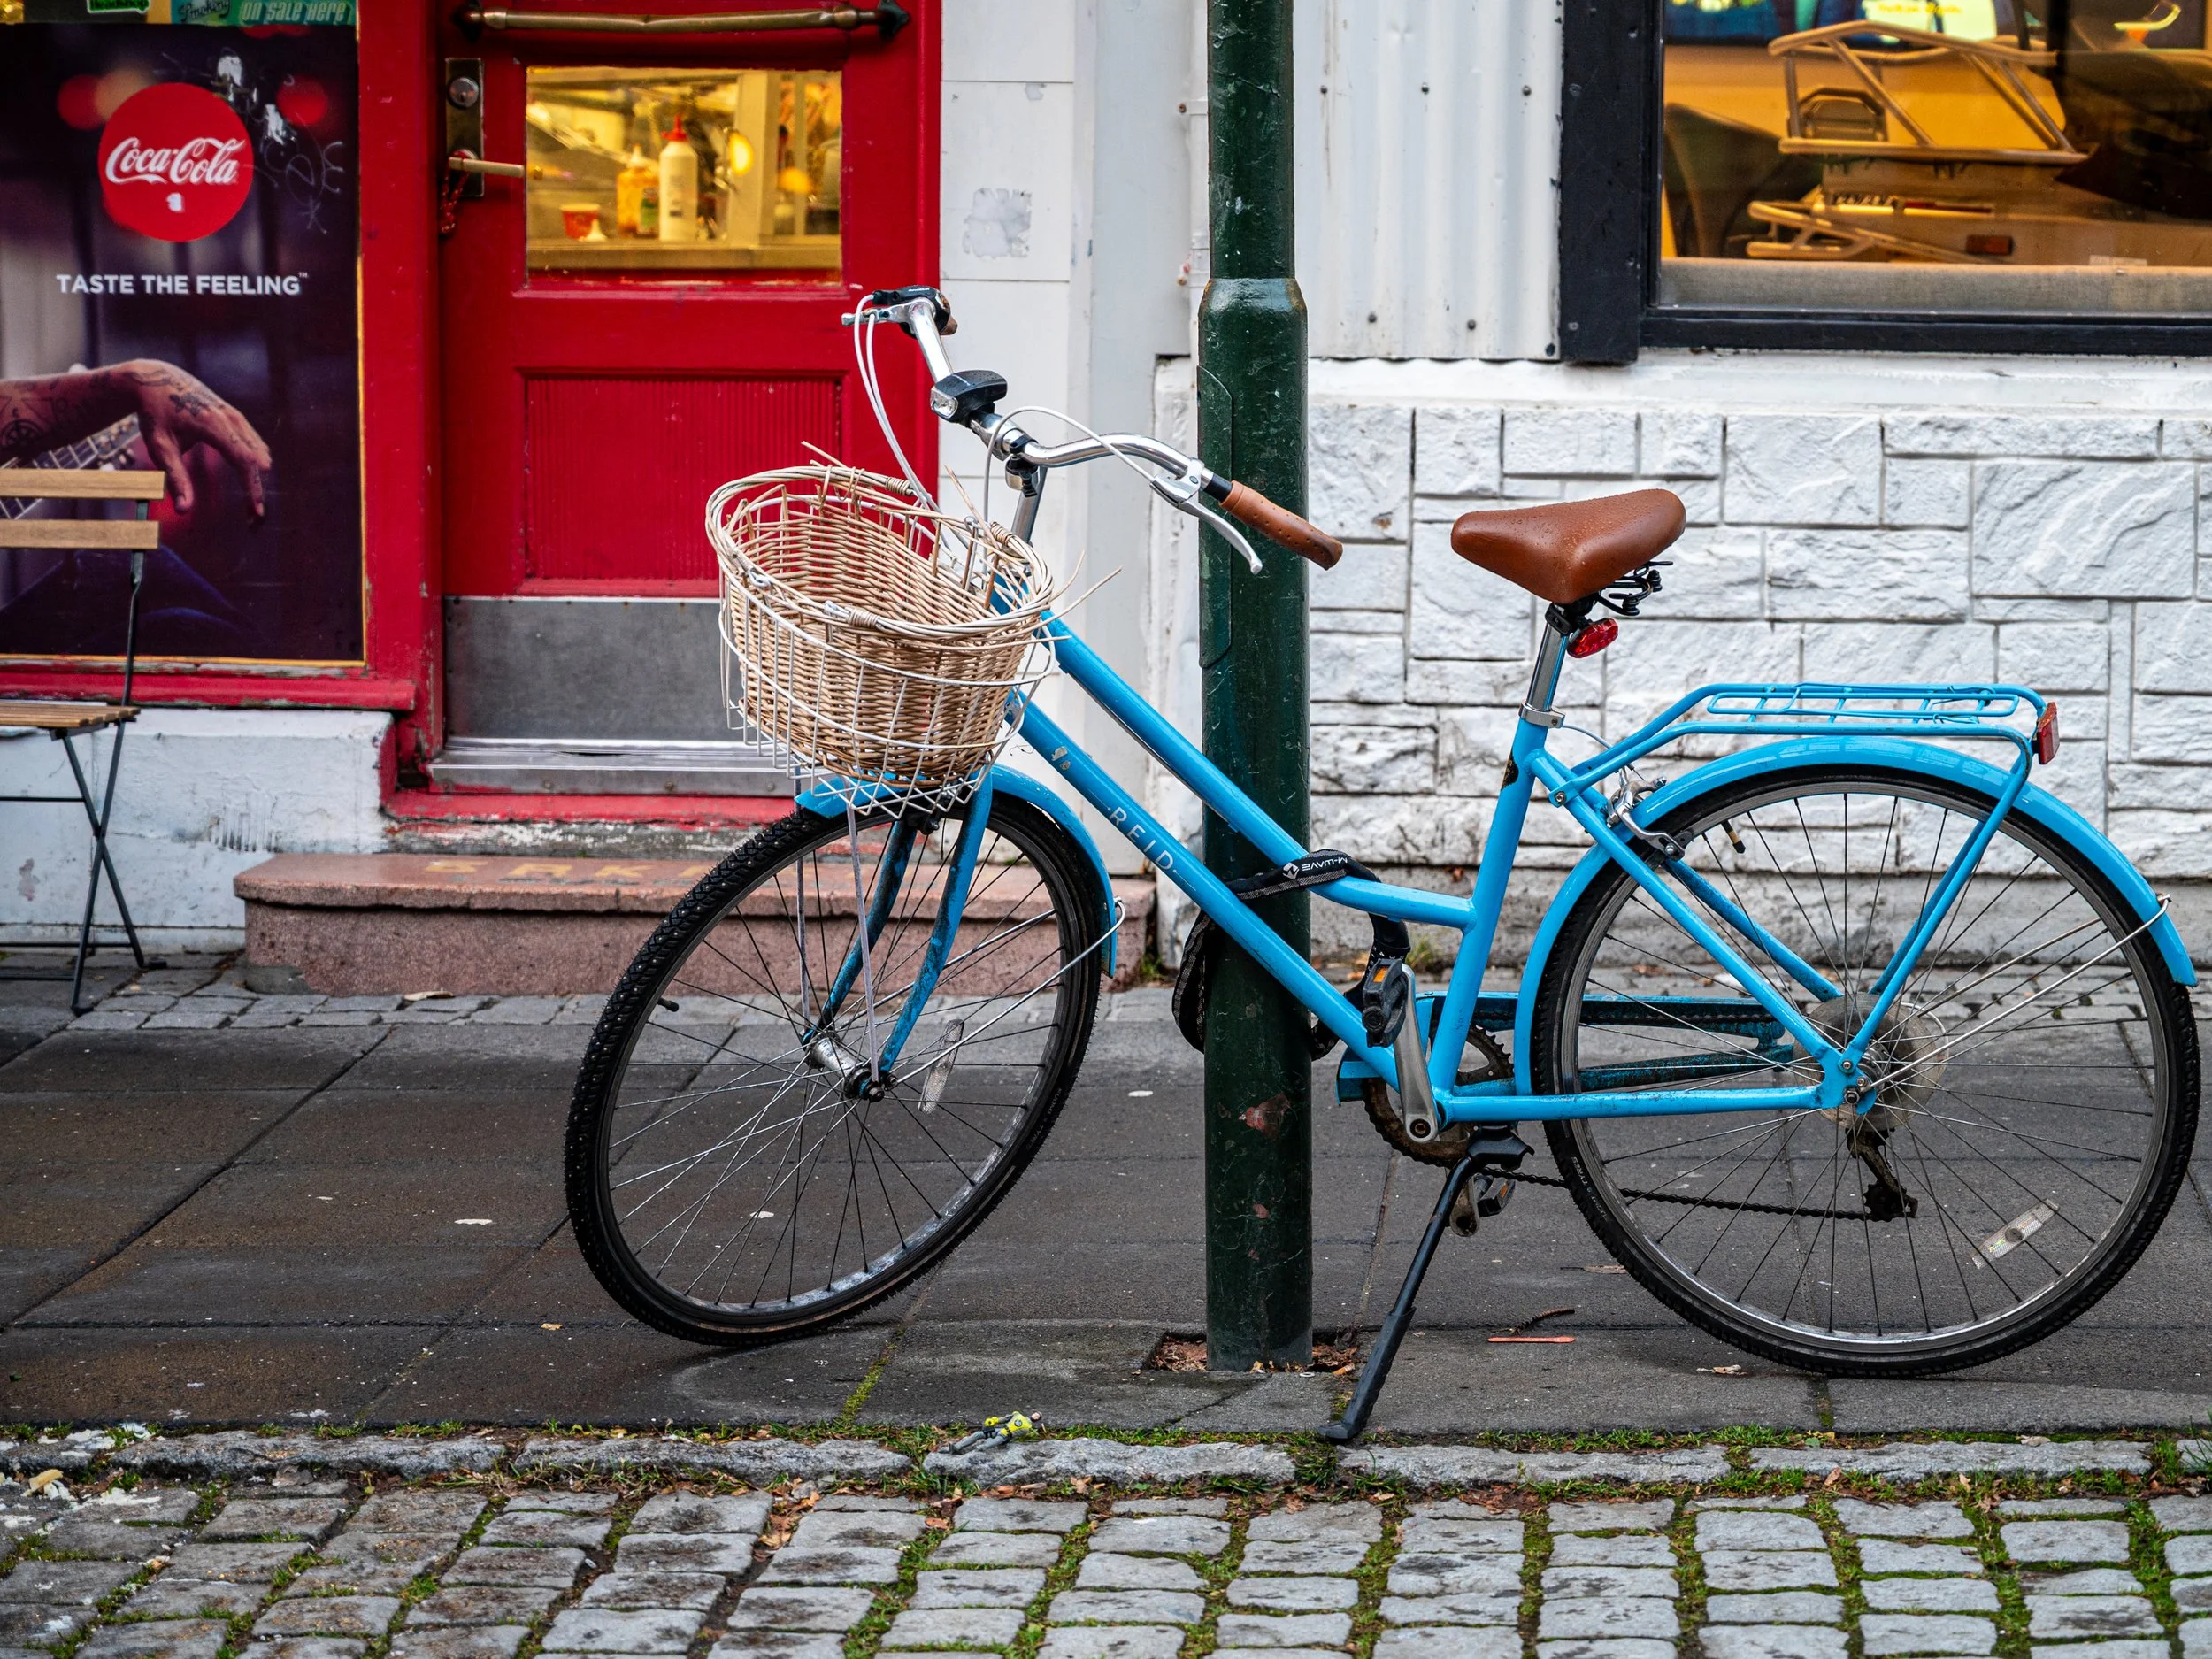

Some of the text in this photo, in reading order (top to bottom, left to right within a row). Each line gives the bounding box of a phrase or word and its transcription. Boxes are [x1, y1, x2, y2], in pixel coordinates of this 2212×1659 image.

[105, 136, 246, 185] Coca-Cola
[56, 274, 134, 294] TASTE
[142, 274, 188, 295] THE
[1109, 806, 1174, 870] REID
[1301, 856, 1348, 872] M-WAVE
